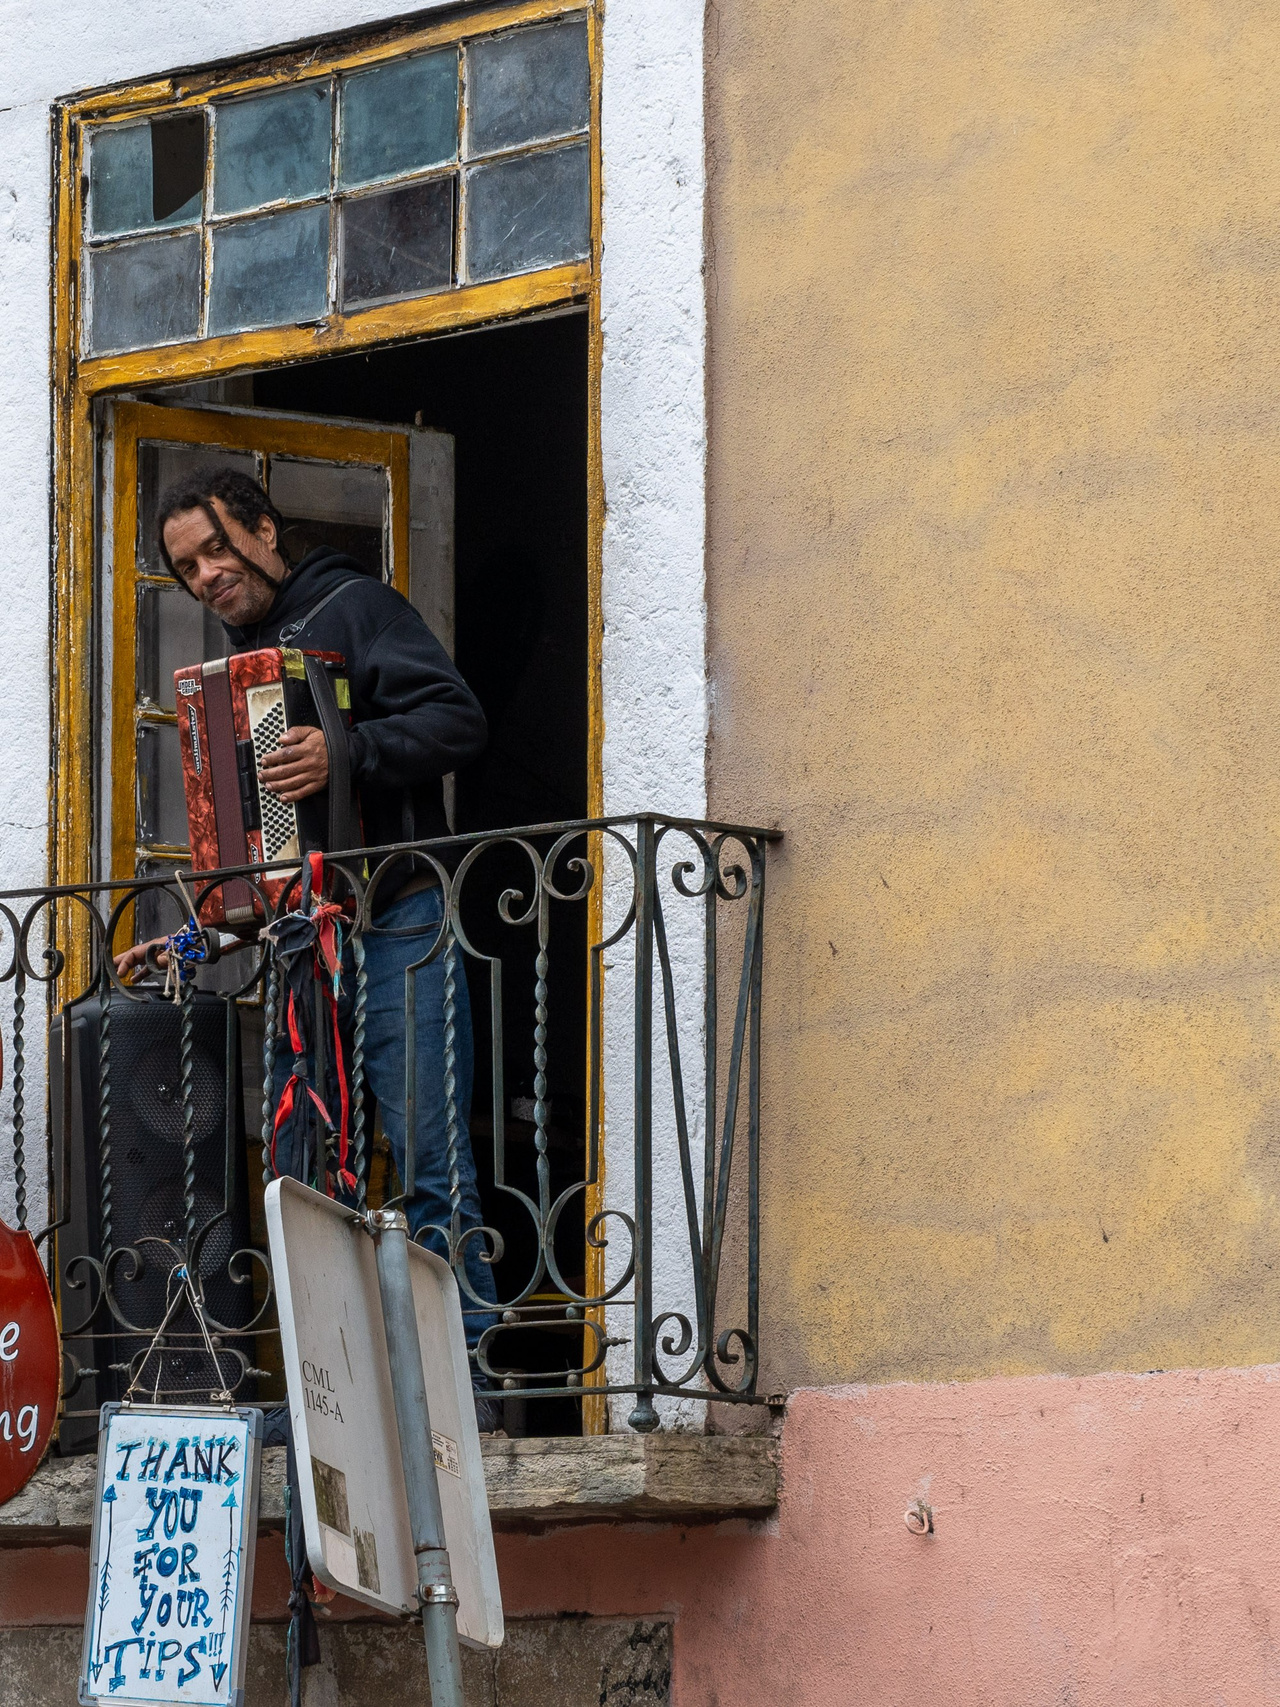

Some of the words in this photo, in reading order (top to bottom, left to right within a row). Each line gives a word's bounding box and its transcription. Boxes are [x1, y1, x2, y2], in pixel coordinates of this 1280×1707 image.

[302, 1360, 335, 1393] CML
[305, 1387, 344, 1423] 1145-A
[116, 1434, 242, 1487] THANK
[137, 1487, 203, 1541] YOU
[133, 1542, 201, 1584] FOR
[131, 1583, 213, 1635] YOUR
